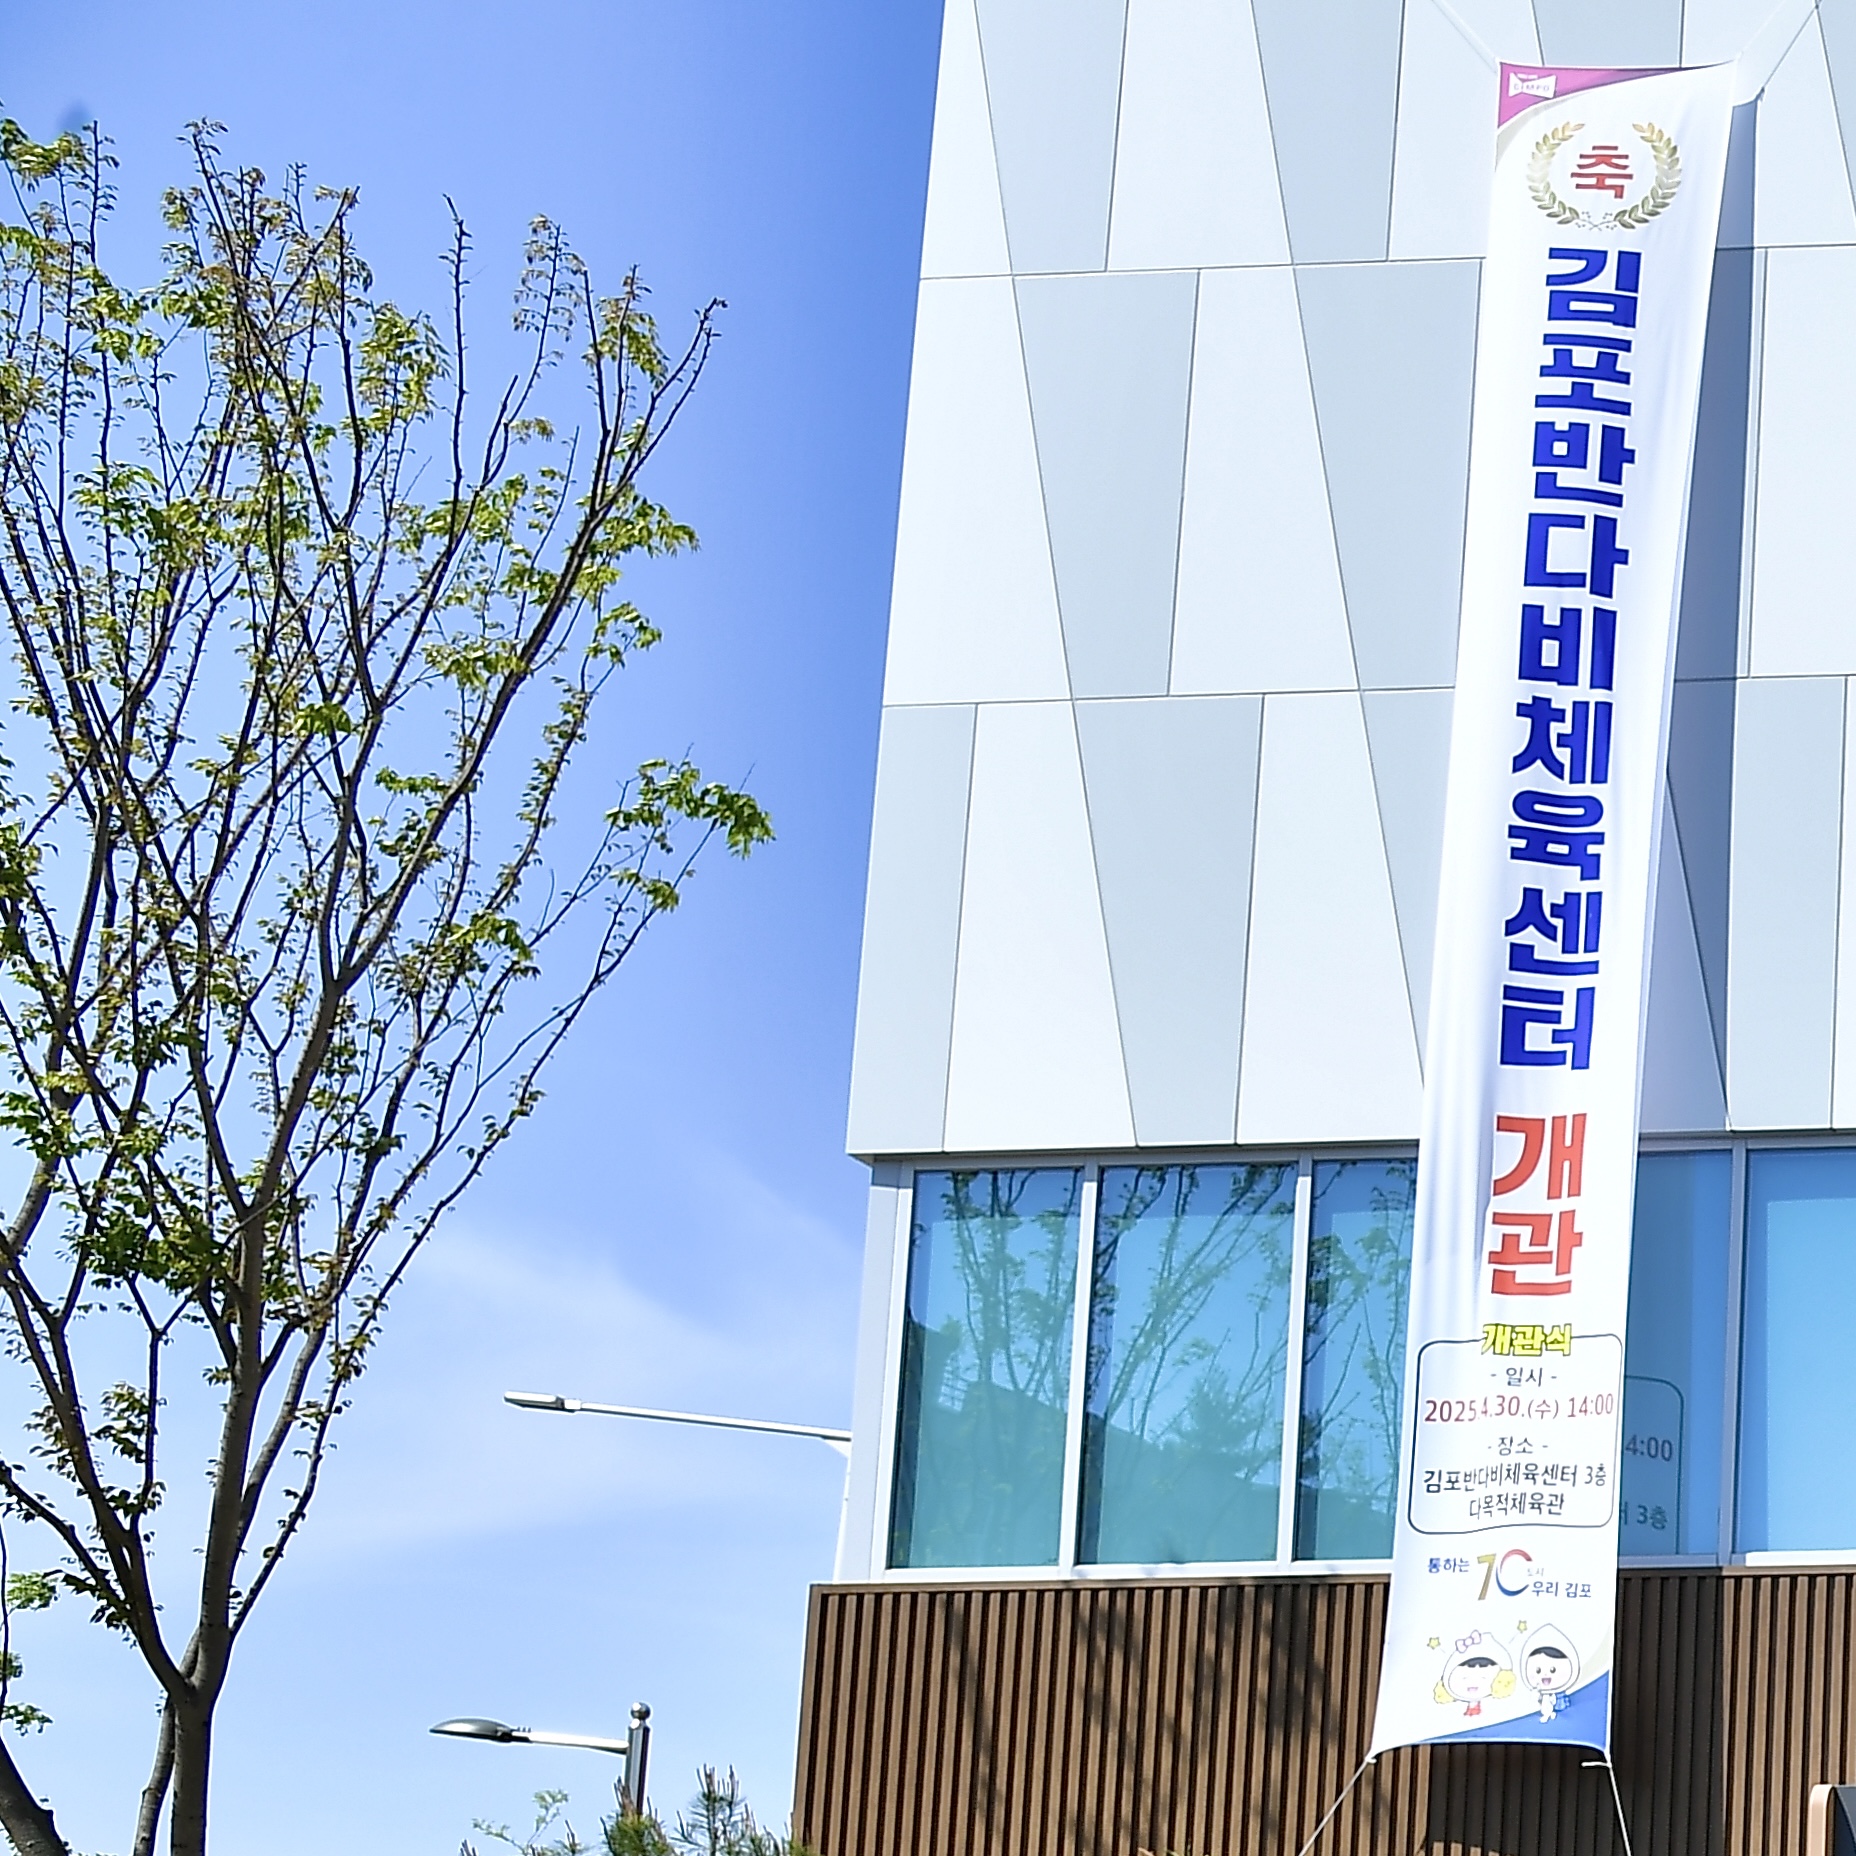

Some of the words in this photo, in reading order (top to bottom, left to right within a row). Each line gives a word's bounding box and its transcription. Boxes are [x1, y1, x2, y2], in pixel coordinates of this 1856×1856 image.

[1571, 145, 1634, 199] 축
[1499, 247, 1642, 1070] 김포반다비체육센터
[1488, 1113, 1587, 1296] 개관
[1481, 1323, 1572, 1356] 개관식
[1505, 1366, 1543, 1387] 일시
[1567, 1393, 1614, 1418] 14:00
[1498, 1435, 1534, 1456] 장소
[1423, 1462, 1577, 1494] 김포반다비체육센터
[1584, 1463, 1607, 1487] 3층
[1469, 1492, 1564, 1520] 다목적체육관
[1636, 1504, 1668, 1530] 3층
[1428, 1557, 1470, 1573] 통하는
[1532, 1580, 1559, 1597] 우리
[1565, 1582, 1592, 1598] 김포
